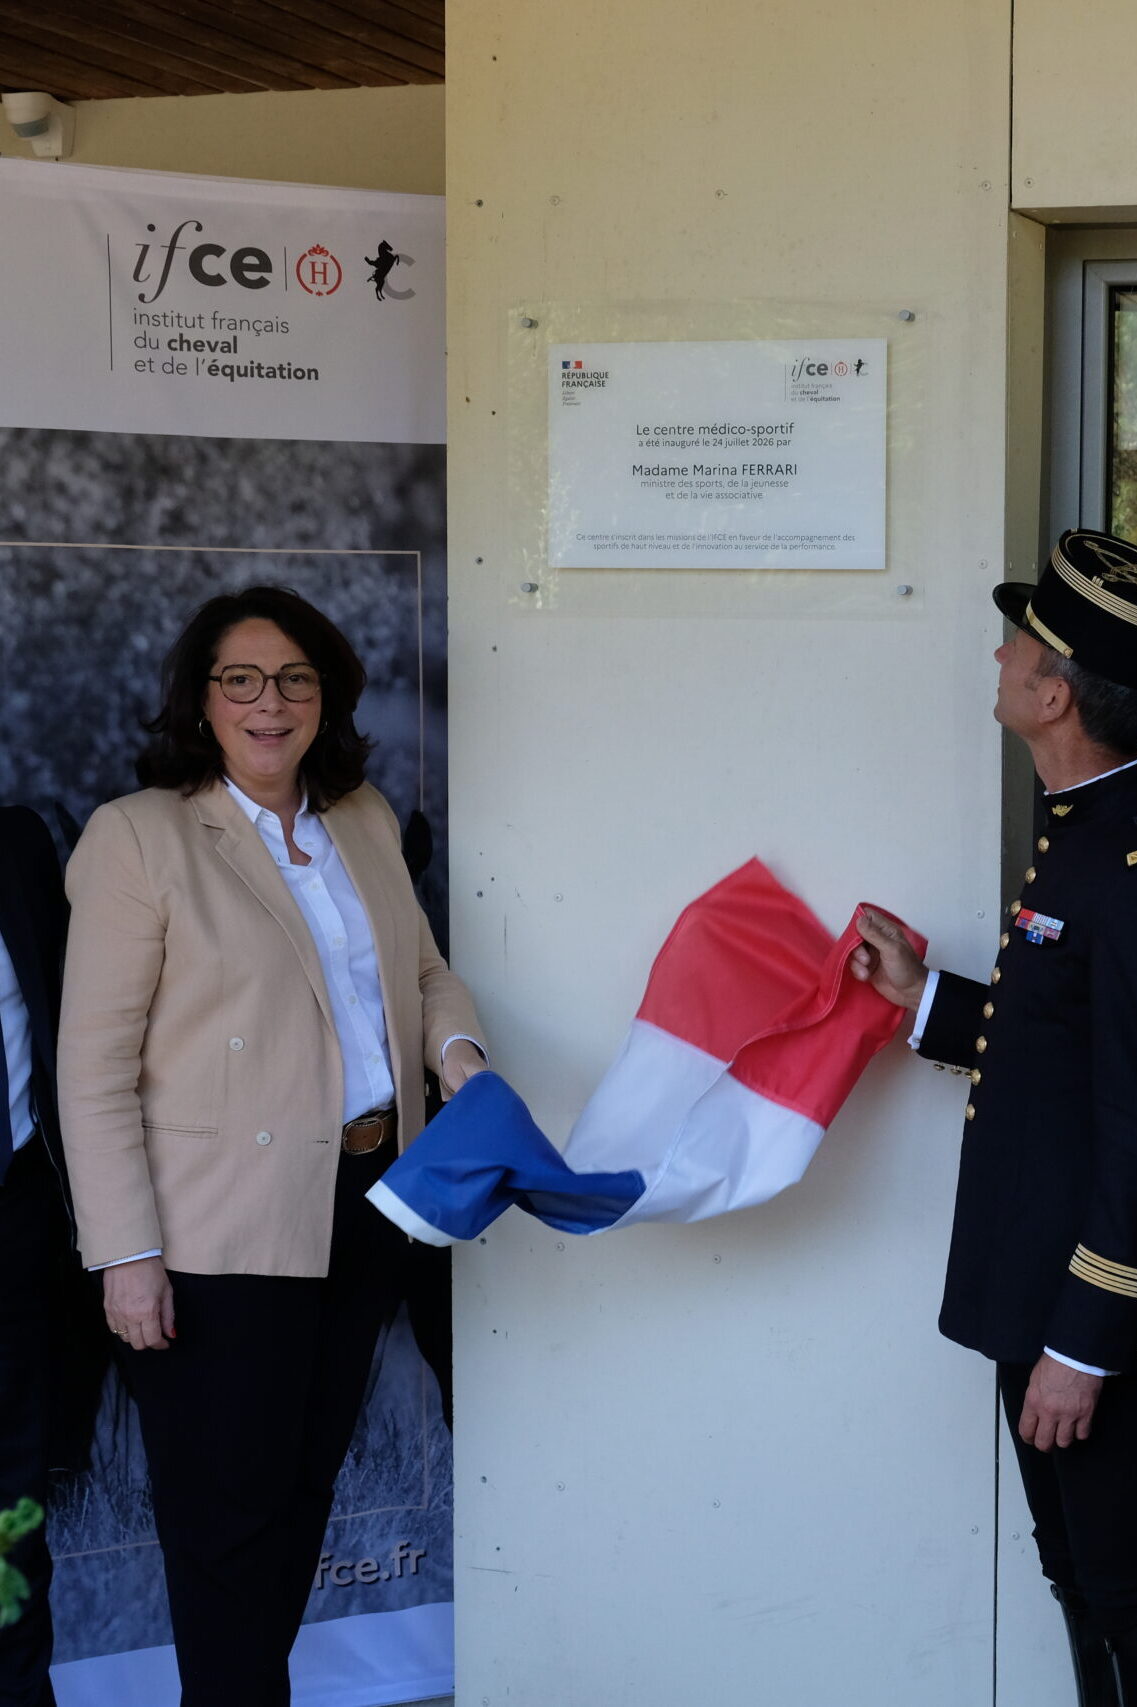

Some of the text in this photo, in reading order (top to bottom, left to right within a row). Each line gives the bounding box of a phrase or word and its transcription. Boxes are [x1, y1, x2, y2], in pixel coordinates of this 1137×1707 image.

[132, 220, 273, 304] ifce
[133, 307, 290, 337] institut français
[133, 331, 238, 354] du cheval
[134, 356, 319, 382] et de l'équitation
[791, 356, 829, 383] ifce
[561, 372, 609, 380] RÉPUBLIQUE
[561, 380, 606, 388] FRANÇAISE
[636, 422, 795, 438] Le centre médico-sportif
[646, 439, 660, 447] été
[662, 439, 700, 449] inauguré
[702, 438, 711, 447] le
[712, 438, 723, 447] 24
[724, 438, 749, 449] juillet
[752, 438, 774, 447] 2026
[776, 440, 791, 449] par
[632, 463, 798, 476] Madame Marina FERRARI
[640, 480, 676, 488] ministre
[678, 479, 693, 488] des
[727, 479, 739, 488] de
[741, 479, 749, 488] la
[749, 479, 789, 489] jeunesse
[665, 490, 763, 499] et de la vie associative
[587, 533, 610, 541] centre
[667, 533, 695, 541] missions
[697, 533, 706, 541] de
[739, 533, 761, 541] faveur
[762, 533, 772, 541] de
[593, 543, 619, 551] sportifs
[620, 542, 630, 550] de
[631, 542, 647, 550] haut
[681, 542, 690, 550] de
[770, 542, 780, 550] de
[781, 542, 788, 550] la
[314, 1540, 425, 1589] fce.fr
